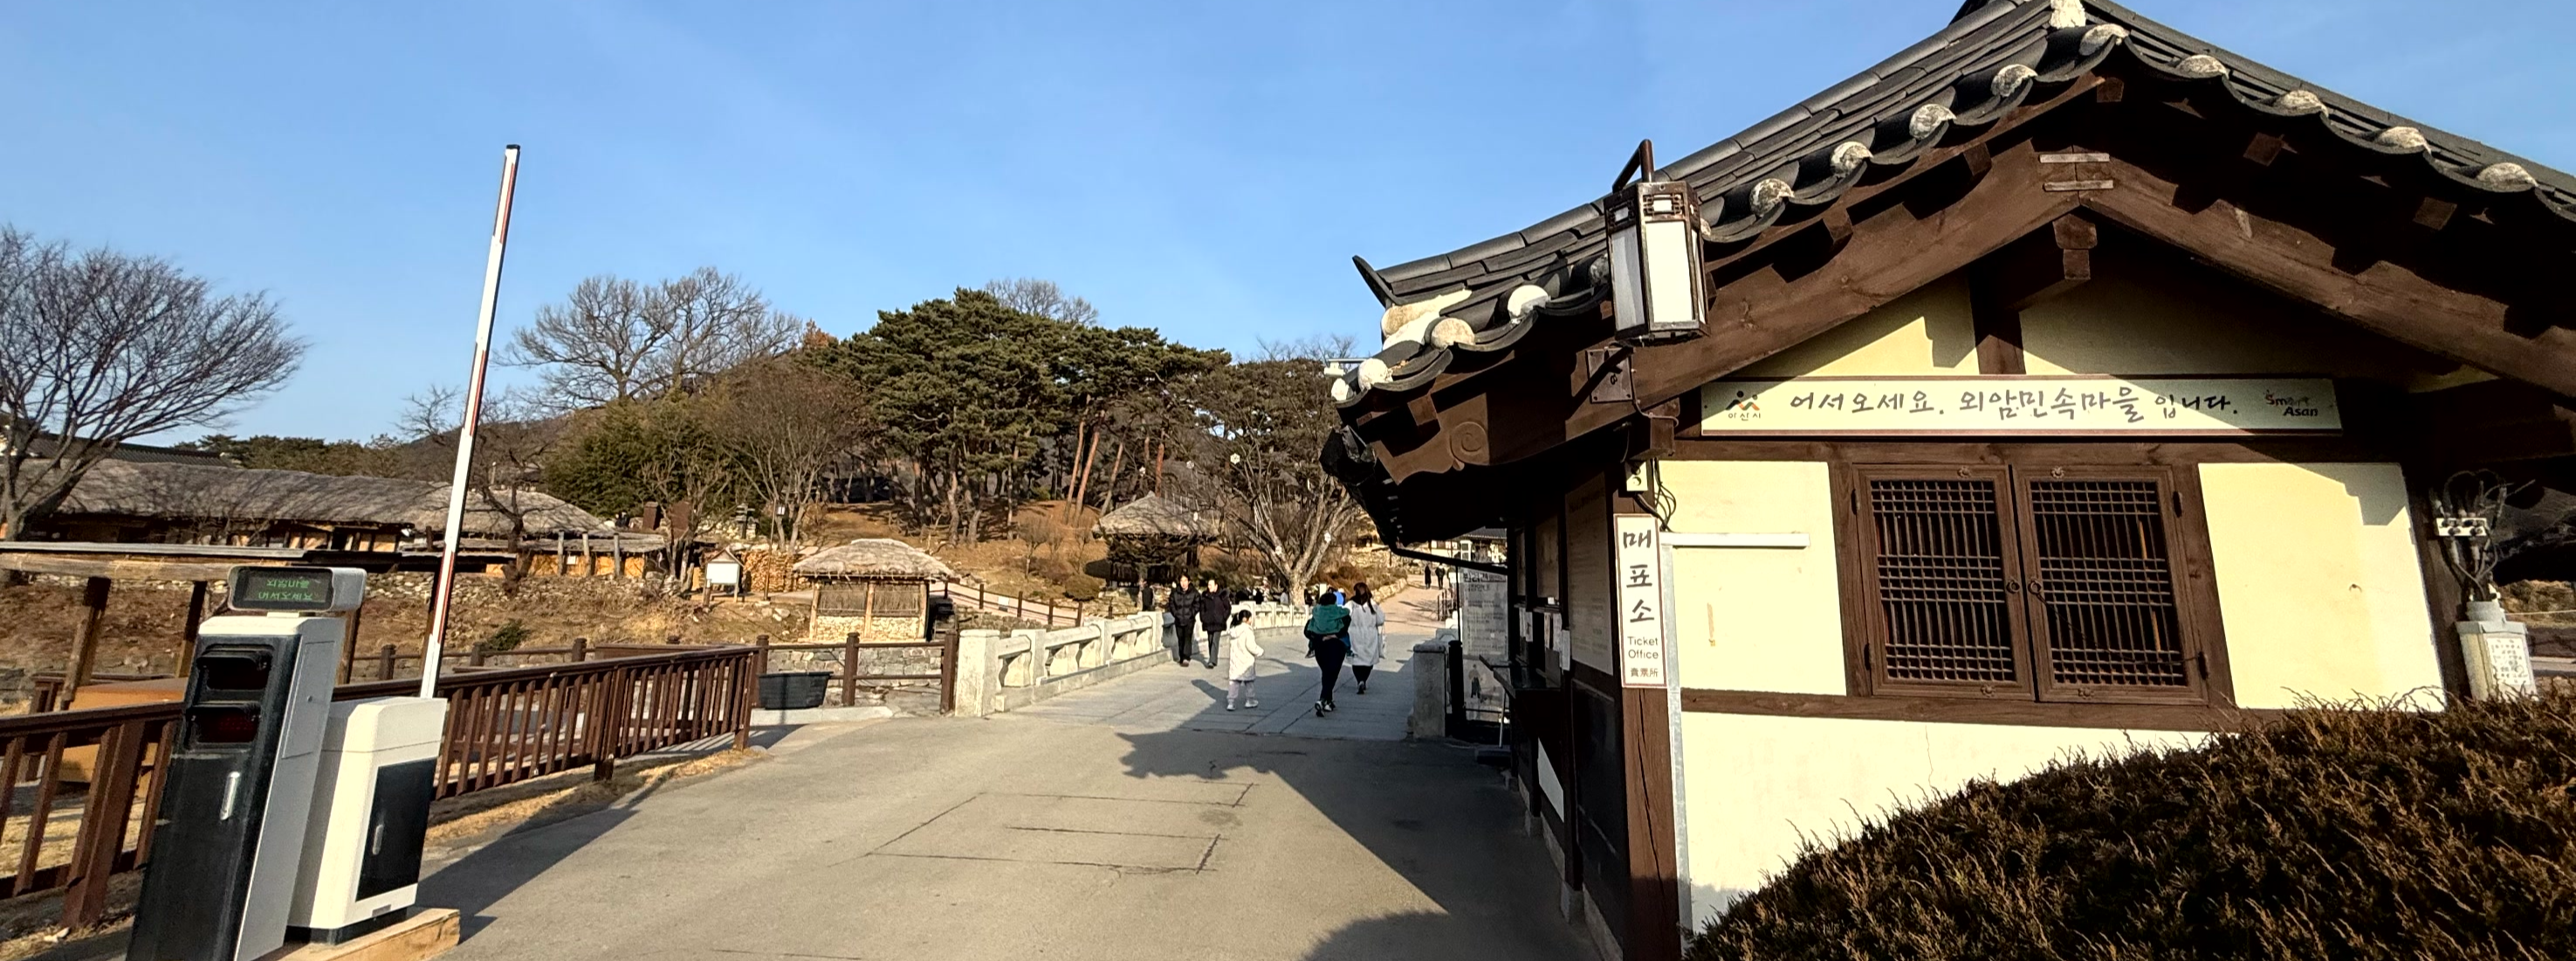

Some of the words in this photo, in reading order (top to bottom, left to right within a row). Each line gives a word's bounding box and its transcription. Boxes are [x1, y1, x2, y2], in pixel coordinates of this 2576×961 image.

[1789, 391, 1945, 415] 어서오세요.
[1959, 387, 2145, 422] 외암민속마을
[2154, 395, 2238, 419] 입니다.
[2283, 406, 2318, 416] Asan
[1728, 413, 1762, 422] 아산시
[1623, 529, 1655, 623] 매표소
[1627, 636, 1659, 646] Ticket
[1628, 649, 1659, 660] Office
